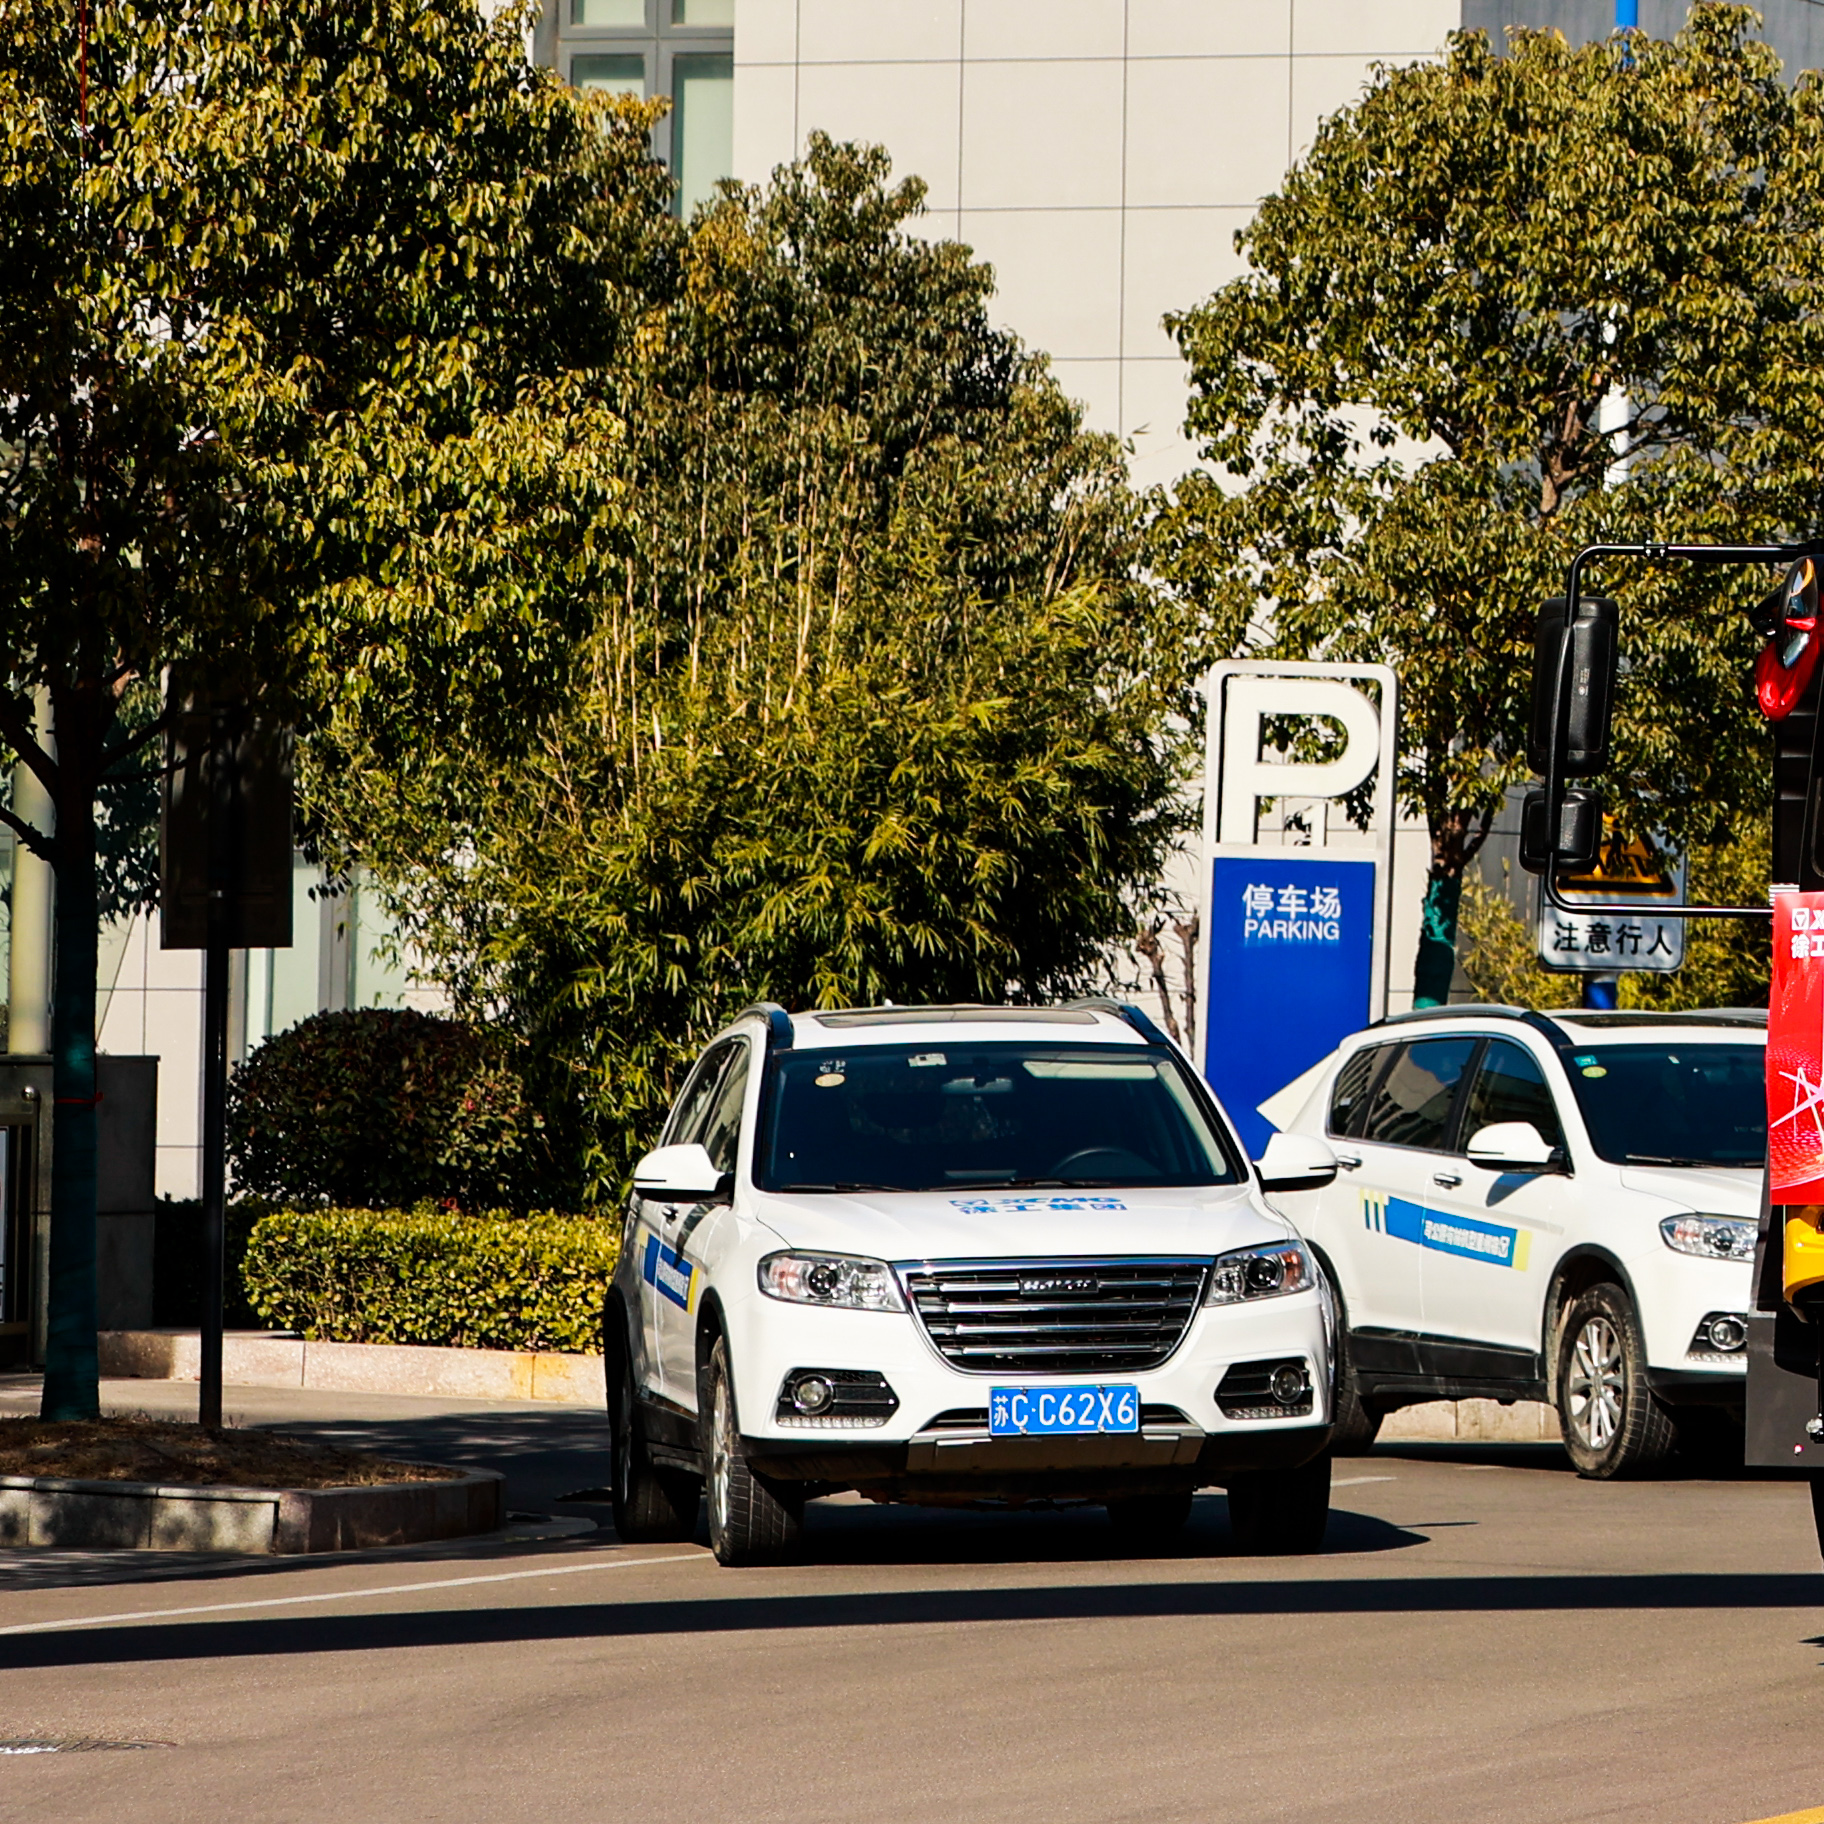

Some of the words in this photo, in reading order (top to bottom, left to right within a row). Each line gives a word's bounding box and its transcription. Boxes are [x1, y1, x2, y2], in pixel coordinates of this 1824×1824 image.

[1219, 677, 1380, 846] P
[1242, 883, 1342, 920] 停车场
[1244, 919, 1341, 940] PARKING
[1552, 922, 1673, 956] 注意行人
